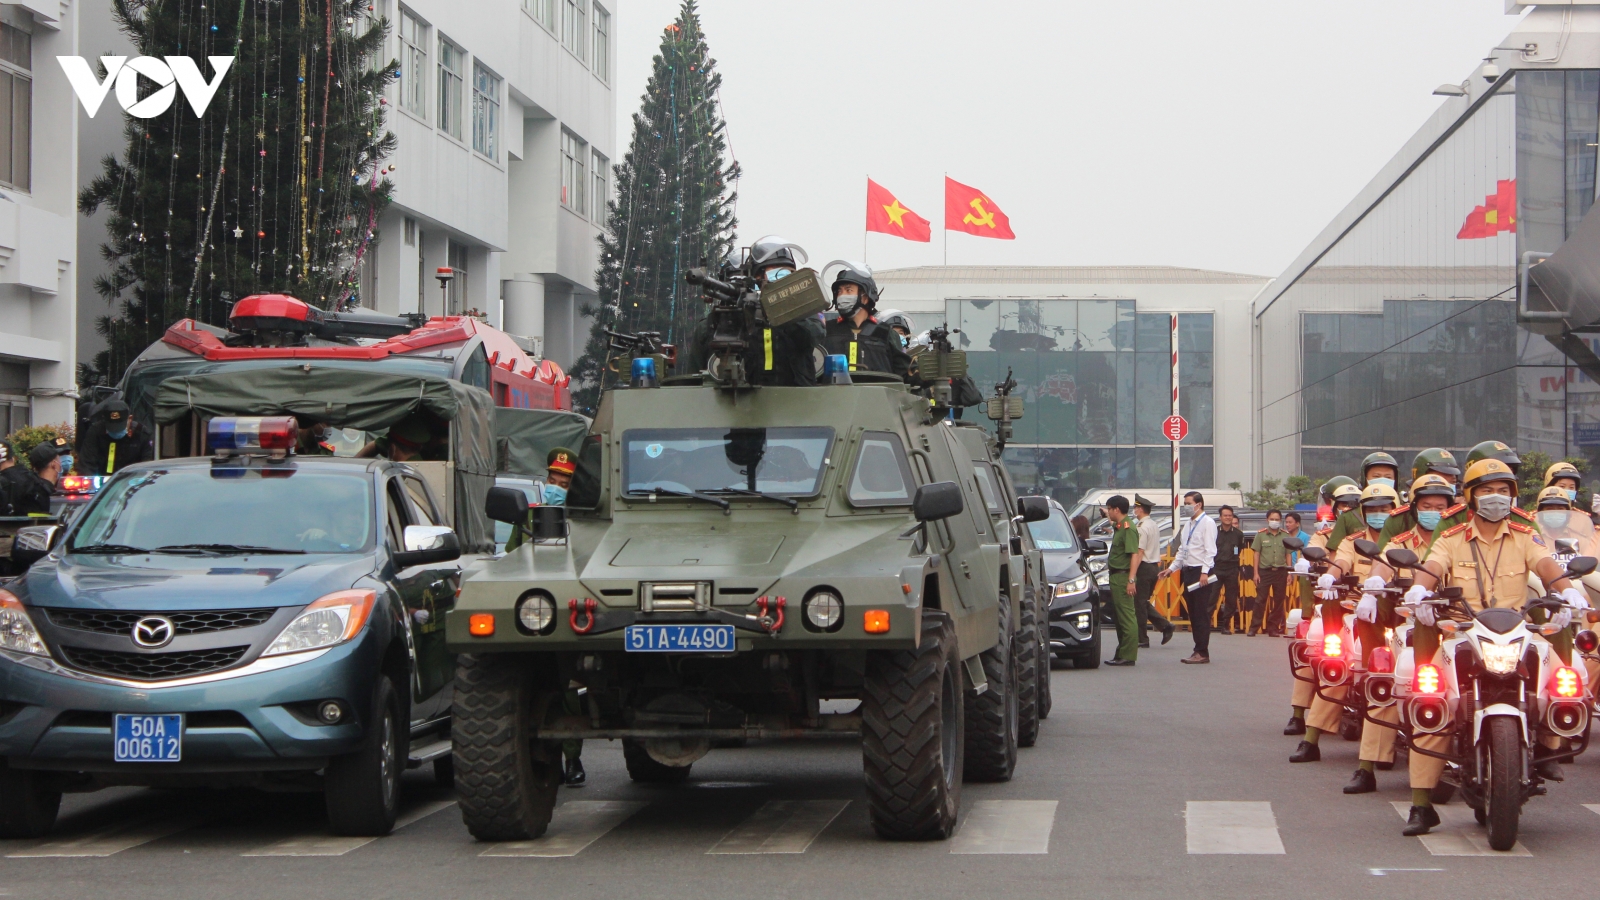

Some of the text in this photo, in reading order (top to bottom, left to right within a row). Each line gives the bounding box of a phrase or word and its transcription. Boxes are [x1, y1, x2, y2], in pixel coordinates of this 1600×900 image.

[1170, 417, 1181, 440] STOP
[632, 627, 728, 649] 51A-4490
[131, 716, 166, 737] 50A
[117, 737, 178, 759] 006.12
